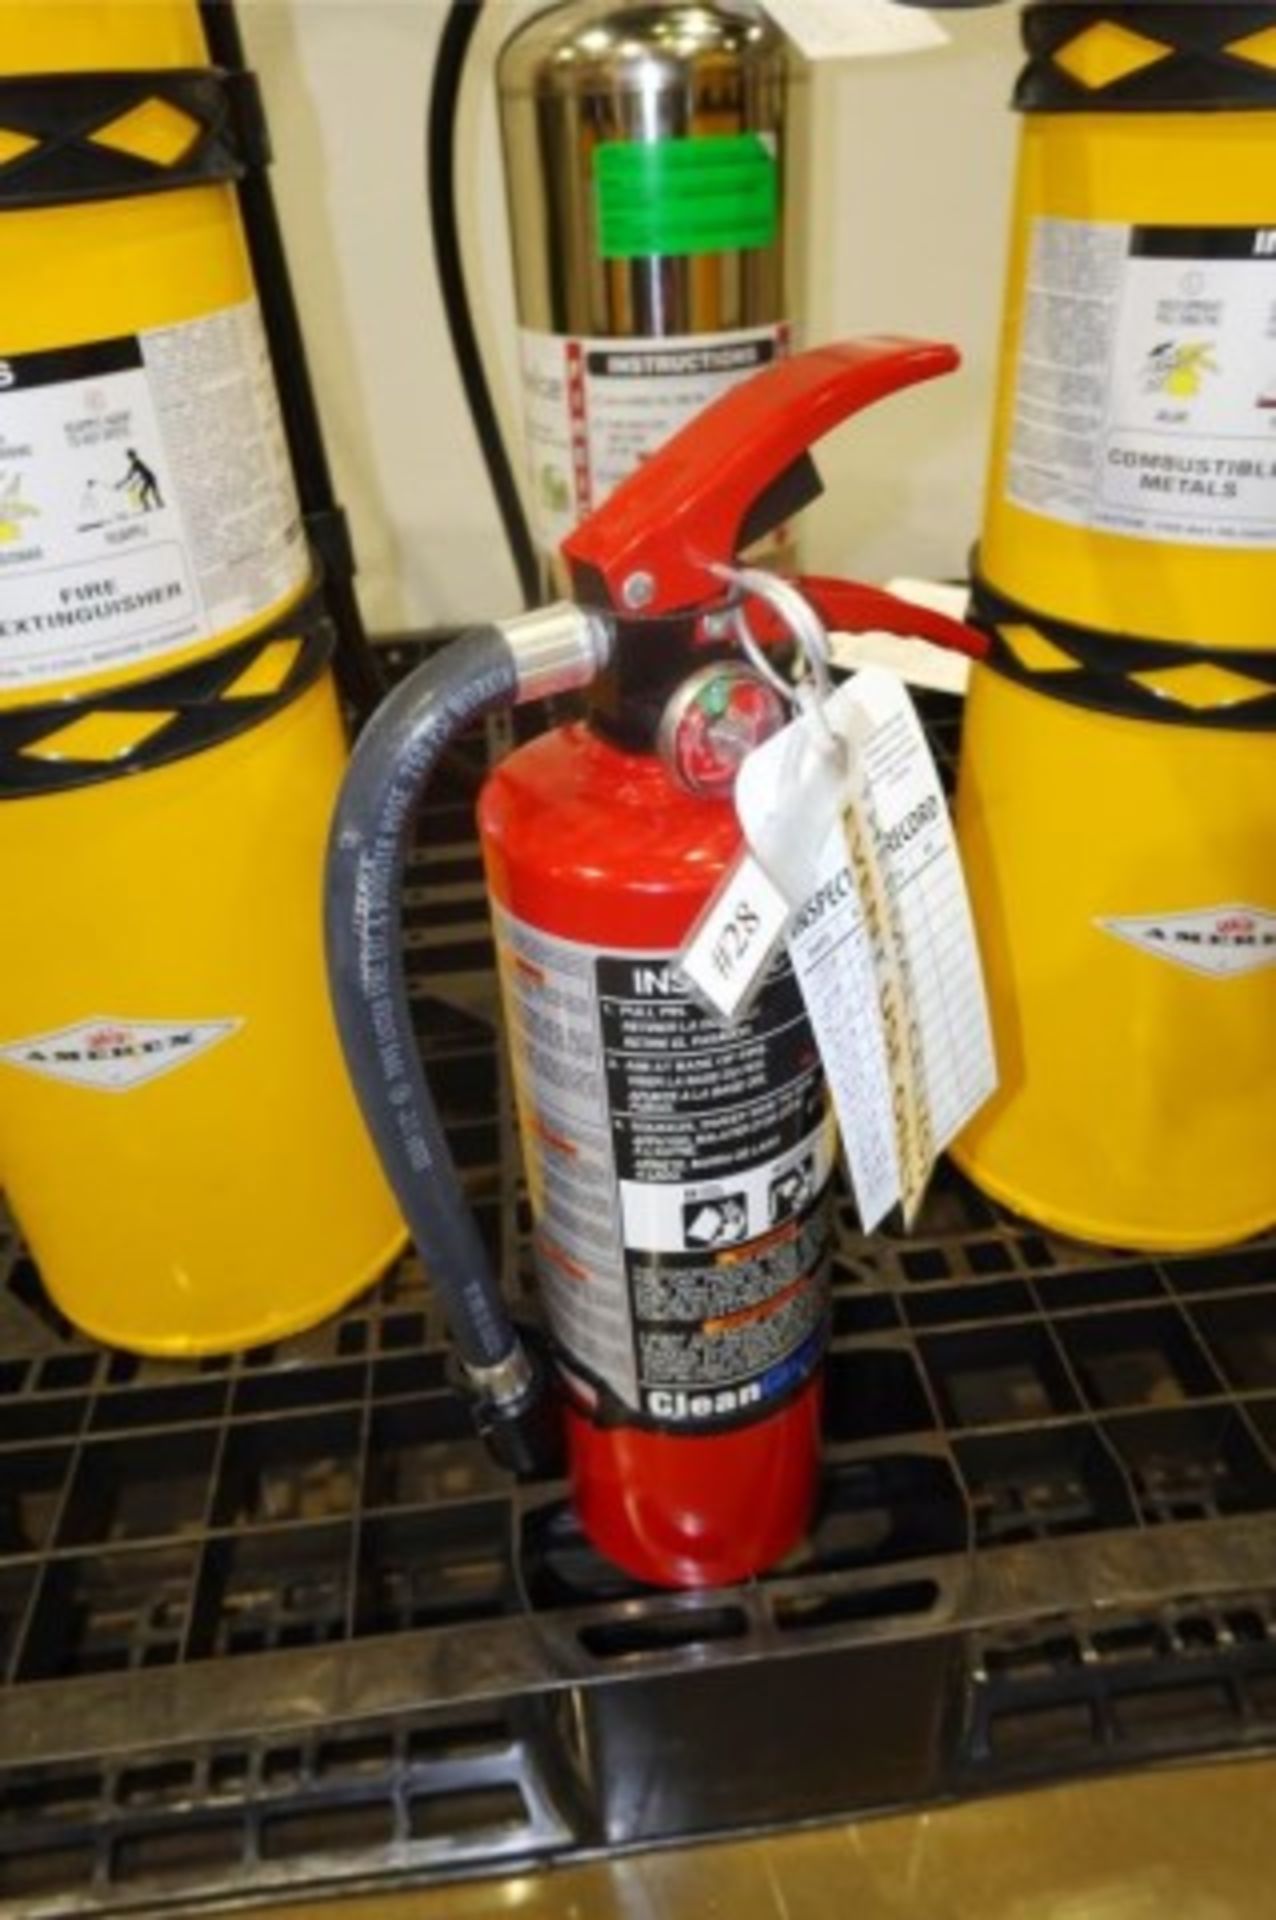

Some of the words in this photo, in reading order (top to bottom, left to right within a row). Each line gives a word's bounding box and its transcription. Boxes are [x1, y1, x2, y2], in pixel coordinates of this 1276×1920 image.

[1139, 474, 1238, 498] METALS
[59, 579, 115, 604] FIRE
[711, 900, 761, 981] #28
